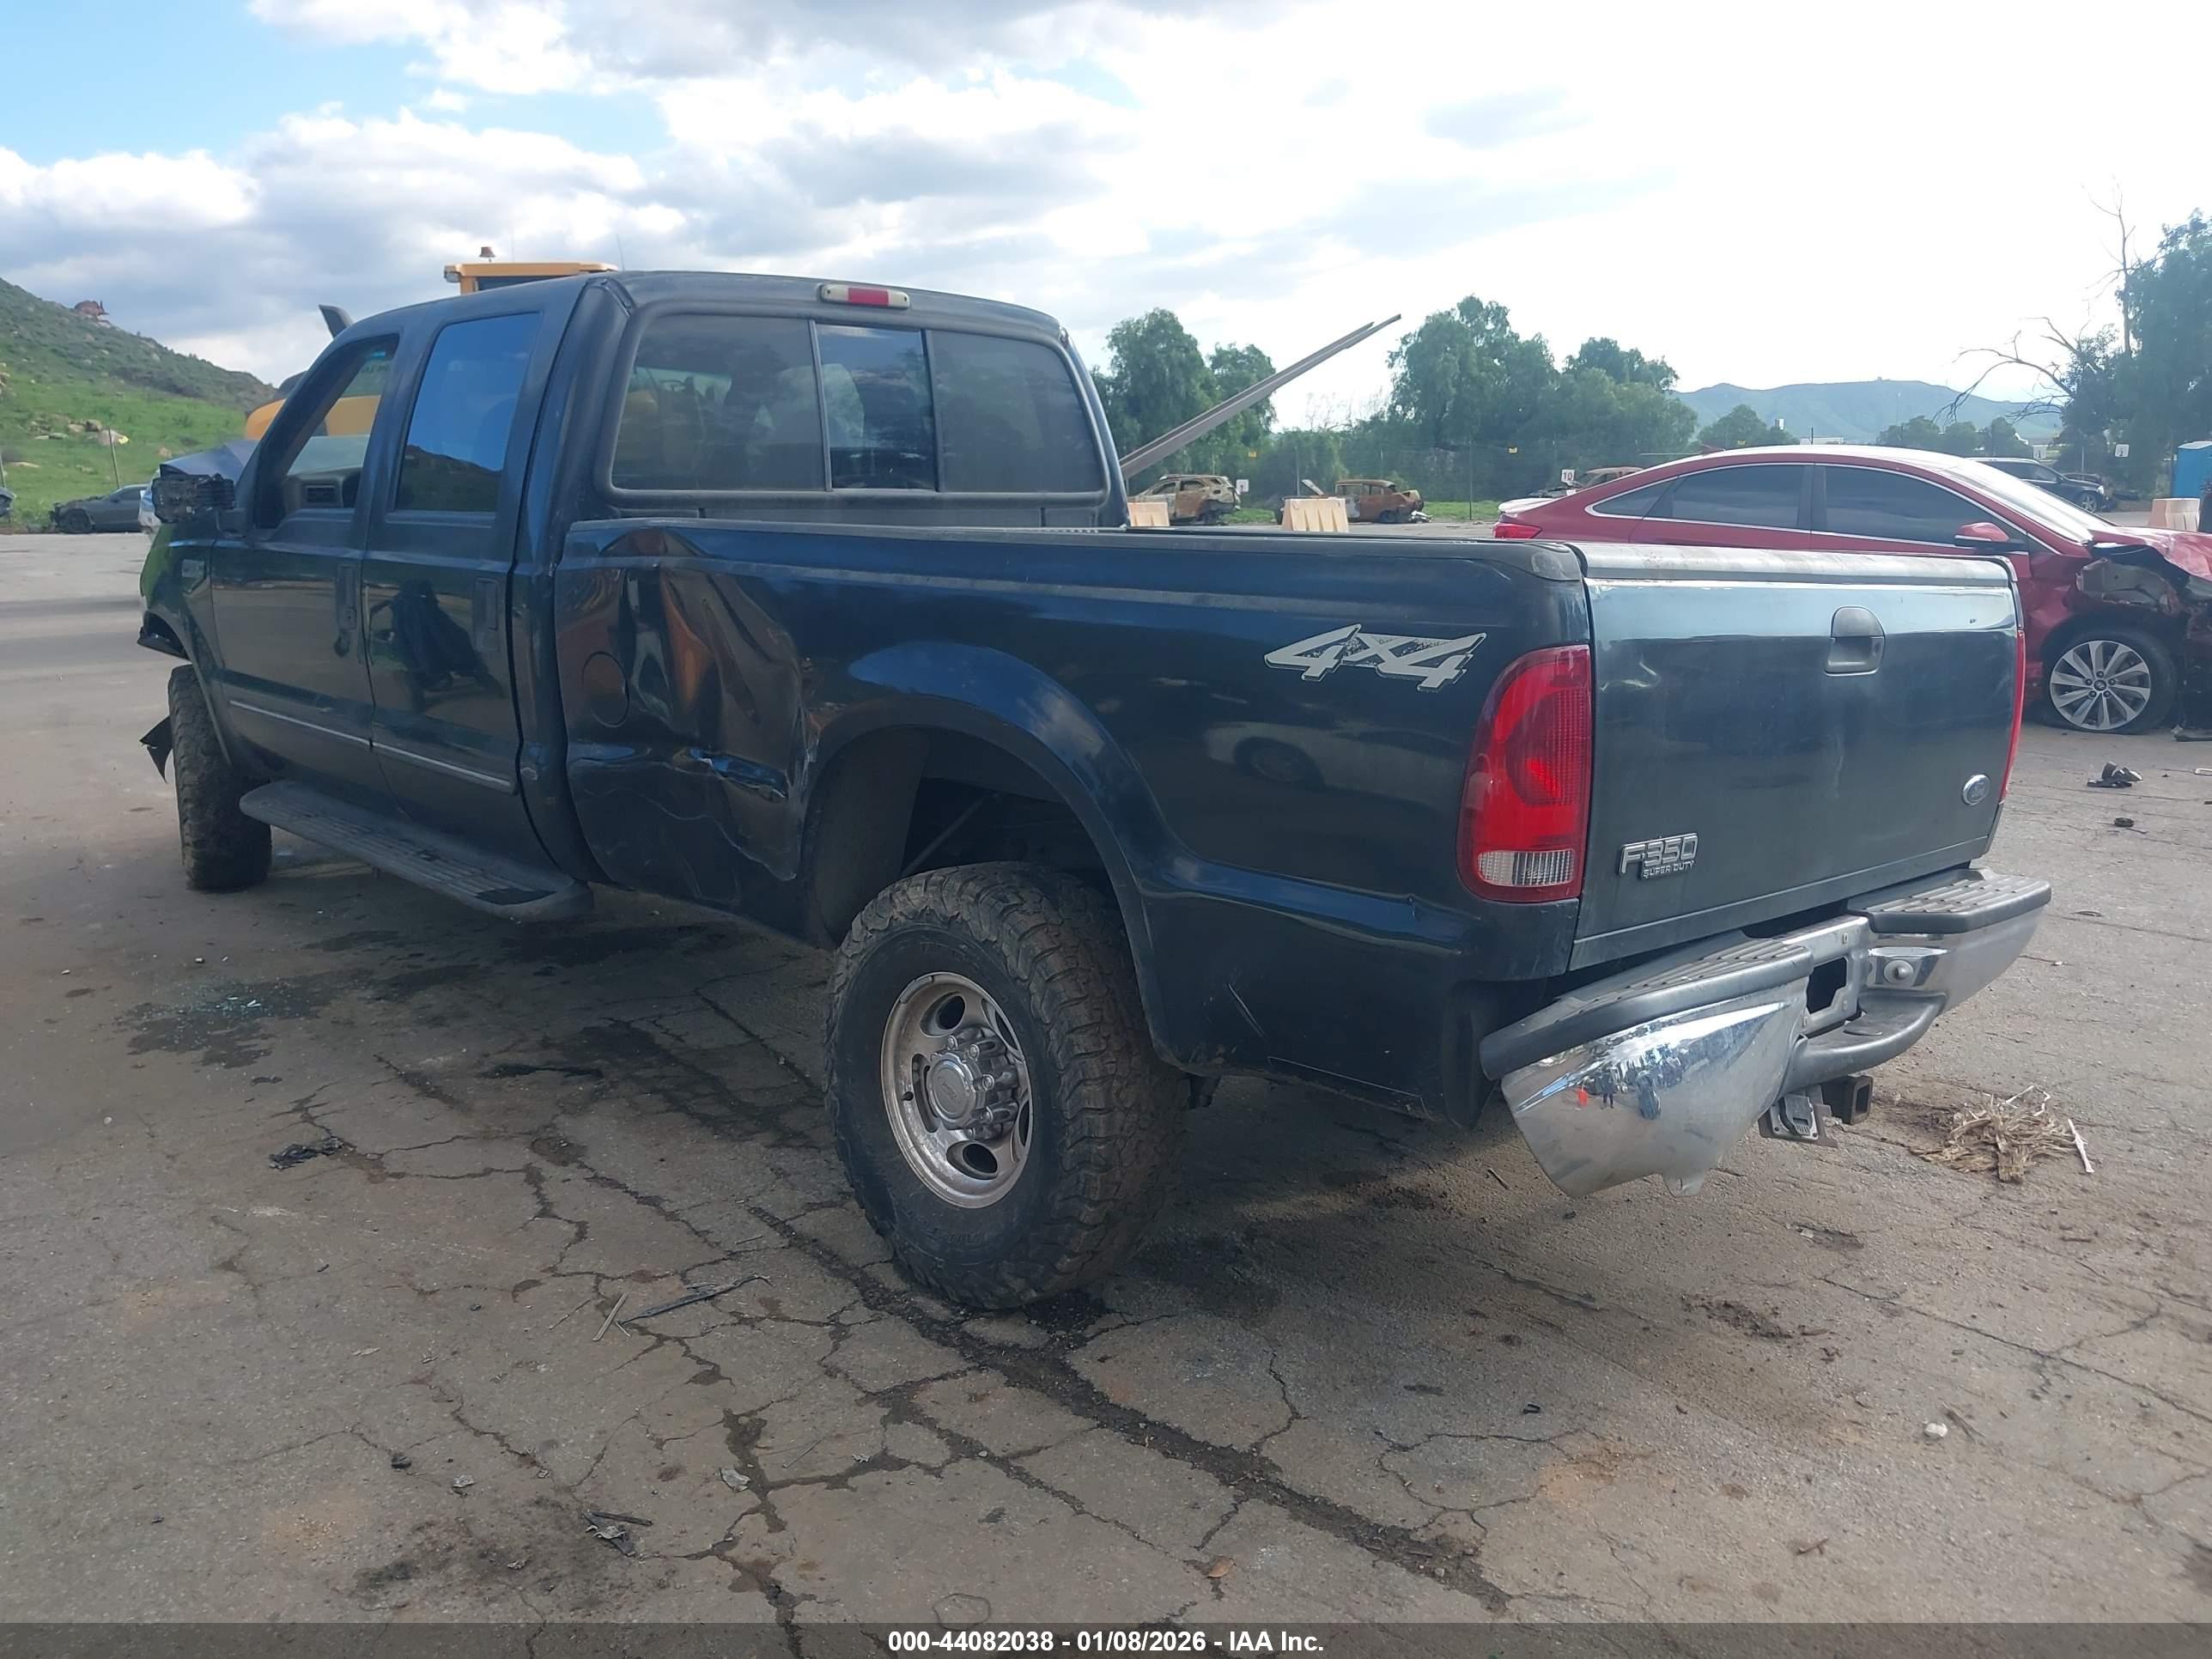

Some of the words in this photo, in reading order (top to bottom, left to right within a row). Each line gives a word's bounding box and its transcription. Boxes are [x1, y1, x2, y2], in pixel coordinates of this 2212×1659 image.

[1563, 471, 1573, 481] 10
[1642, 864, 1671, 879] SUPER
[1673, 860, 1695, 872] DUTY
